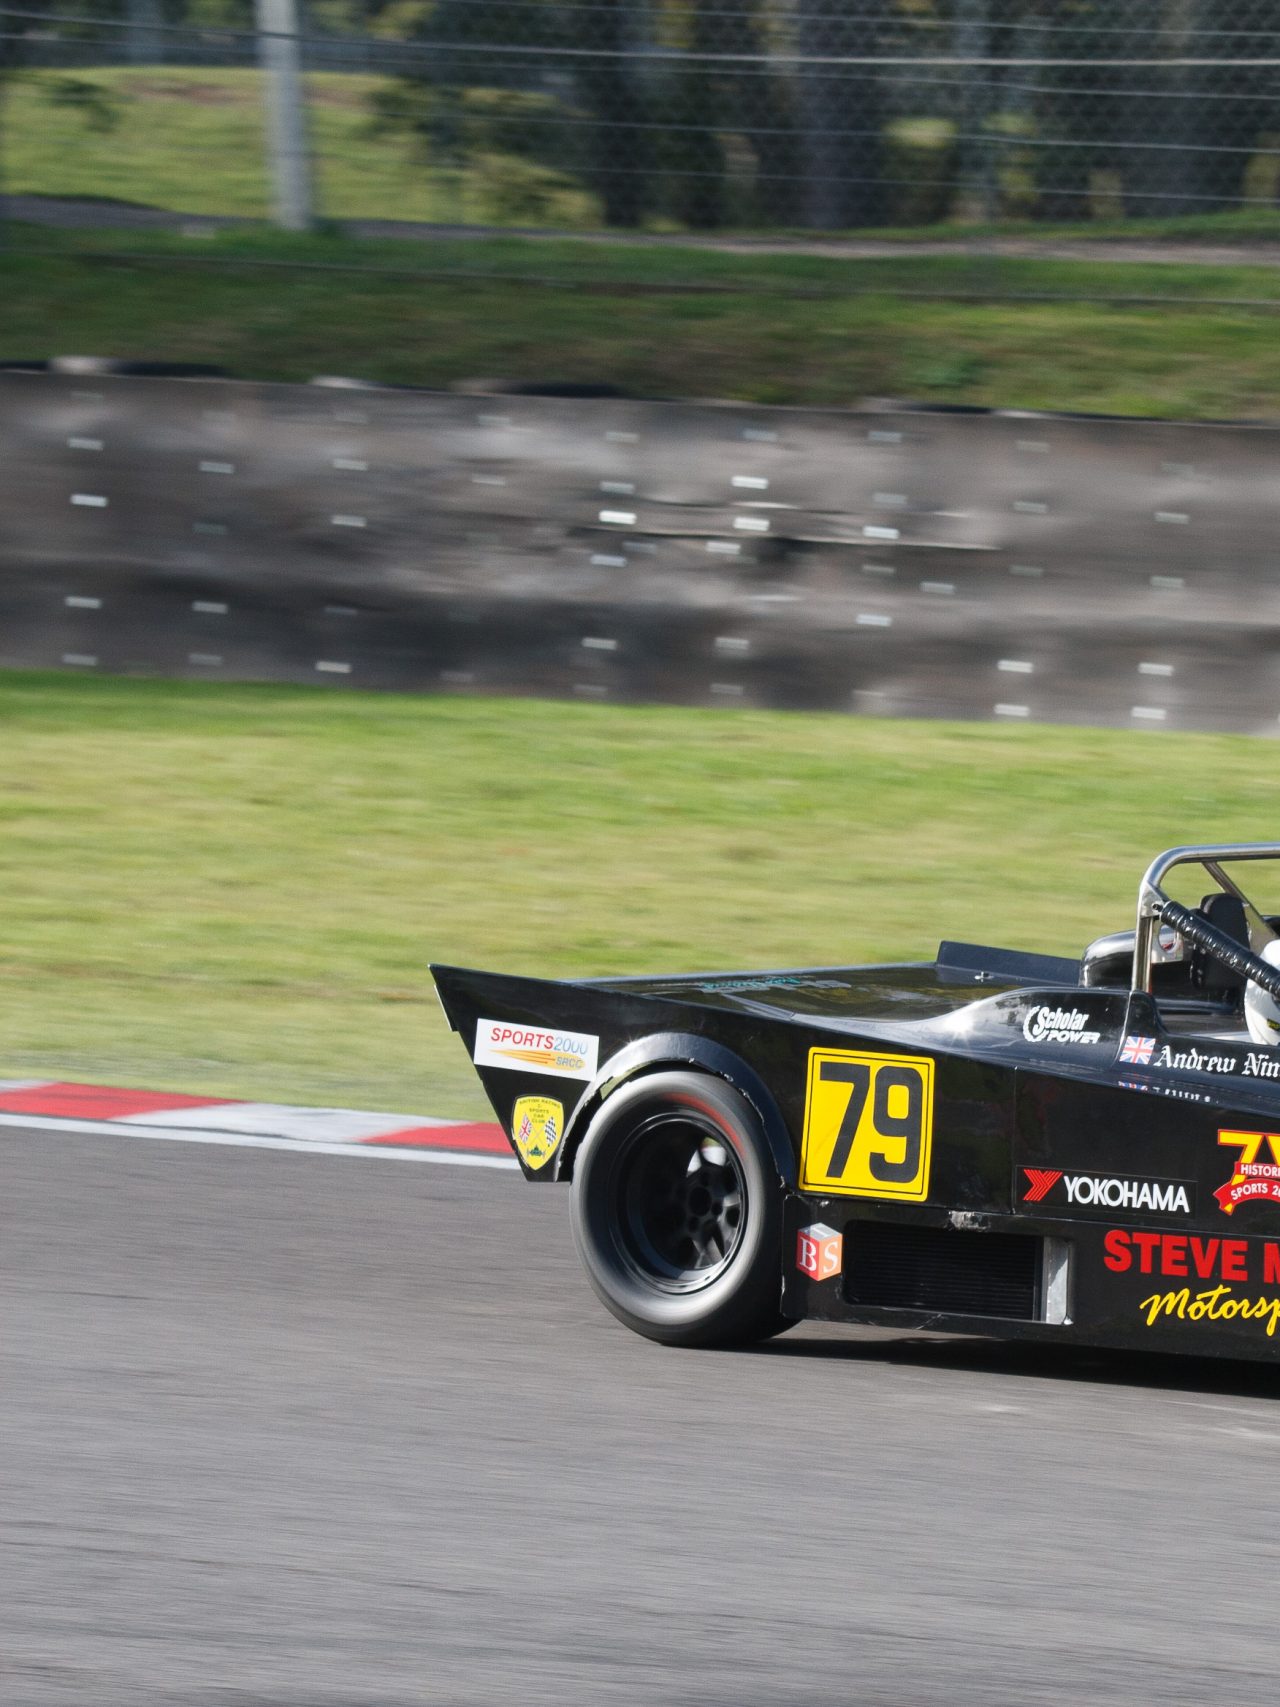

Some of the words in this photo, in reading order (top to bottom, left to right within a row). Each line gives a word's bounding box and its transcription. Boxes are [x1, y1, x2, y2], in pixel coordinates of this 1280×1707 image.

[1032, 1006, 1090, 1036] Scholar
[1047, 1030, 1101, 1044] POWER
[1153, 1045, 1236, 1073] Andrew
[819, 1061, 924, 1184] 79
[1063, 1175, 1190, 1213] YOKOHAMA
[1230, 1183, 1268, 1201] SPORTS
[1103, 1229, 1249, 1282] STEVE
